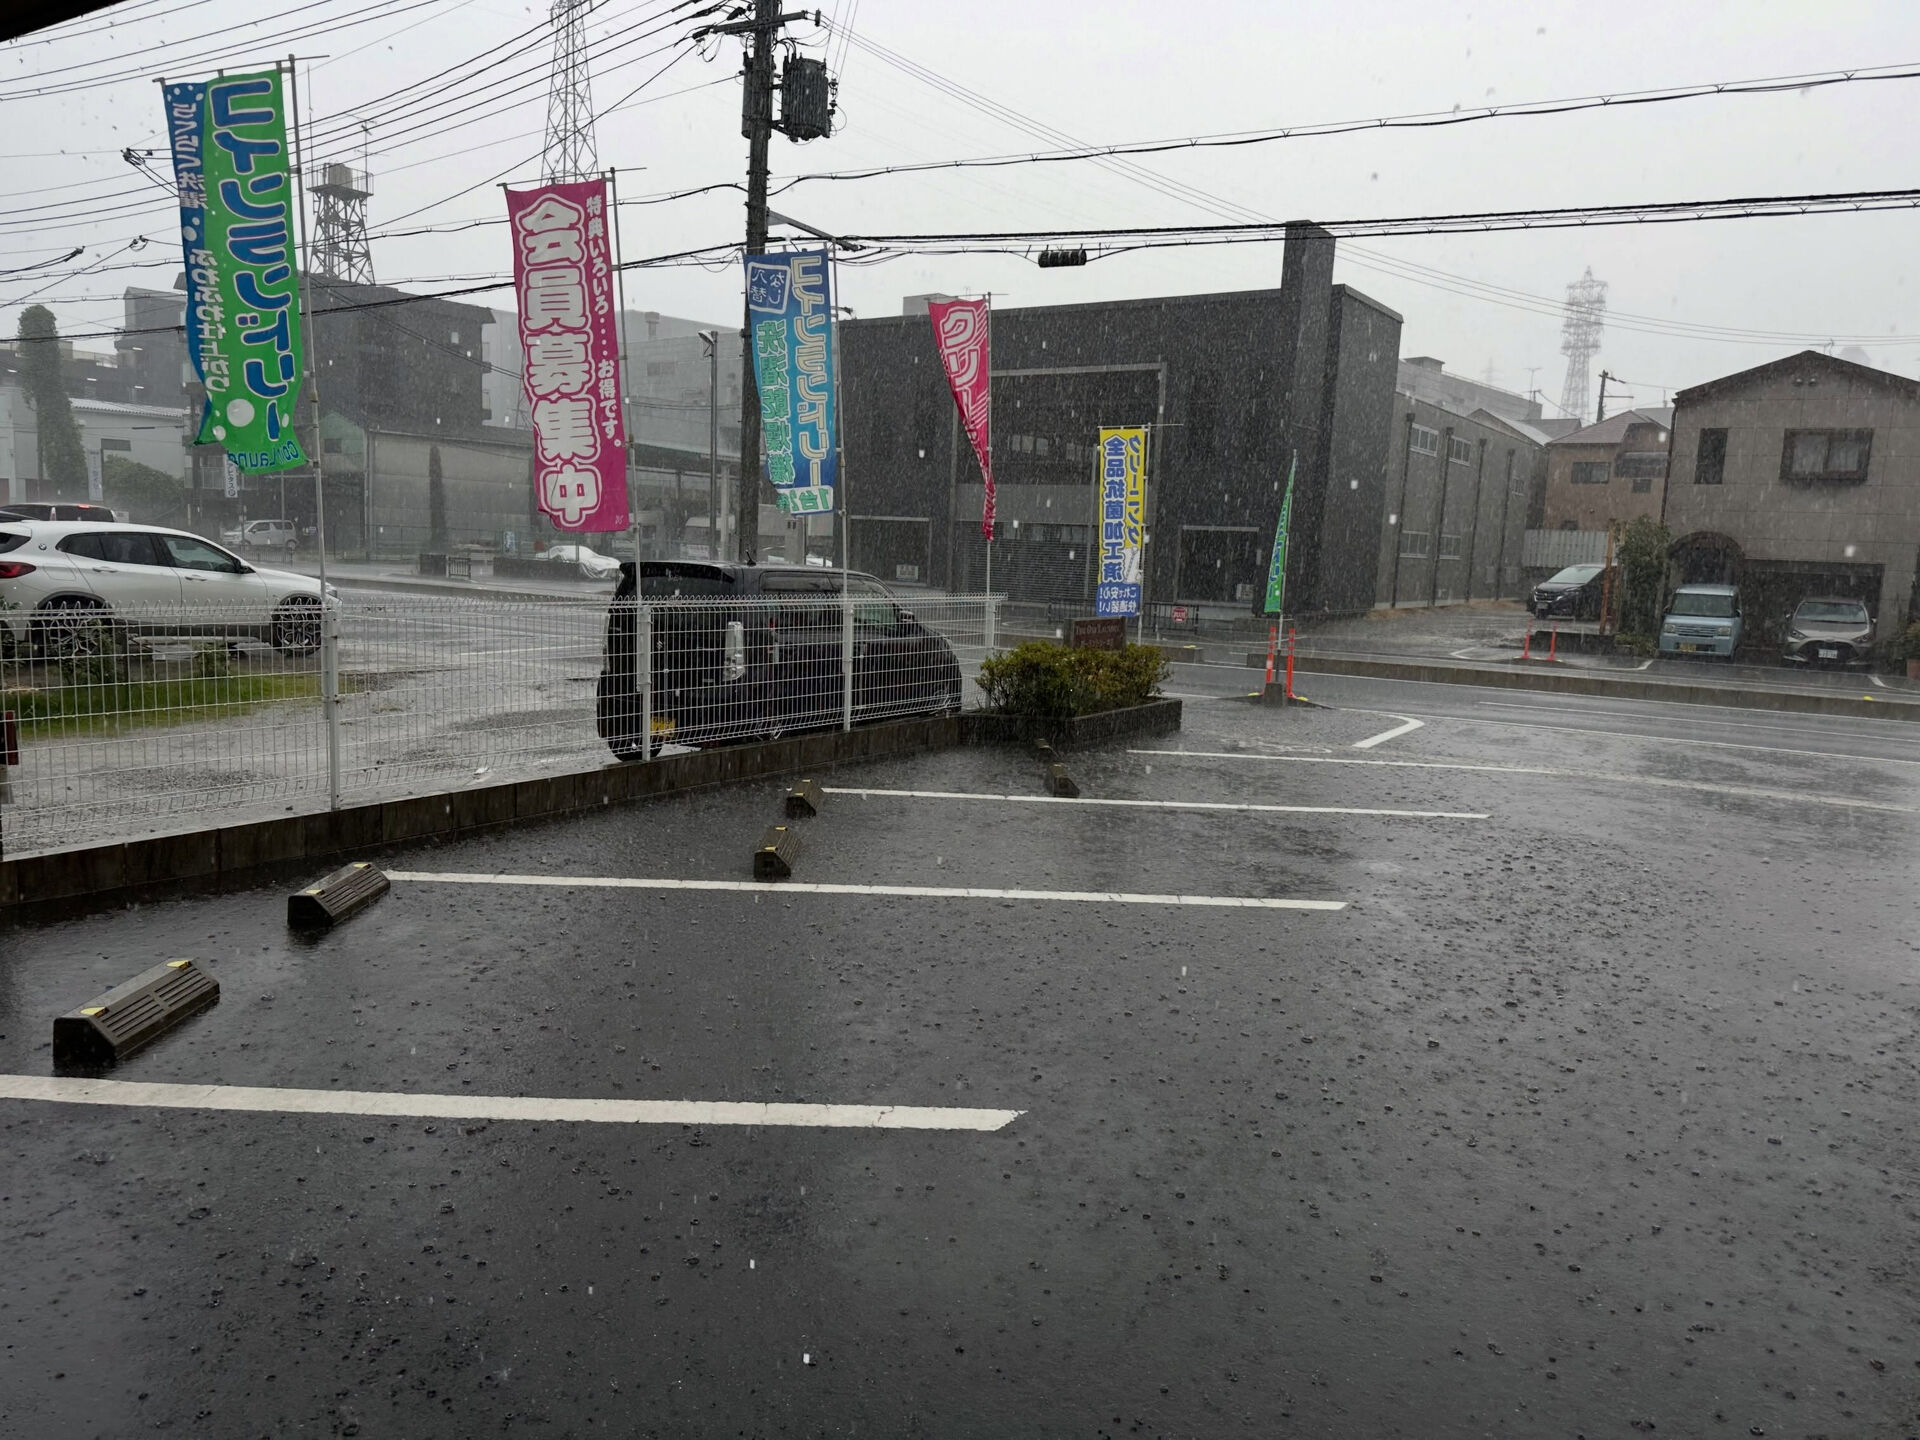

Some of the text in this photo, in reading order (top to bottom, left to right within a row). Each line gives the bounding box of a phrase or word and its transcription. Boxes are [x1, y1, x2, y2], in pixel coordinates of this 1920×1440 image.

[517, 195, 601, 526] 会員募集中
